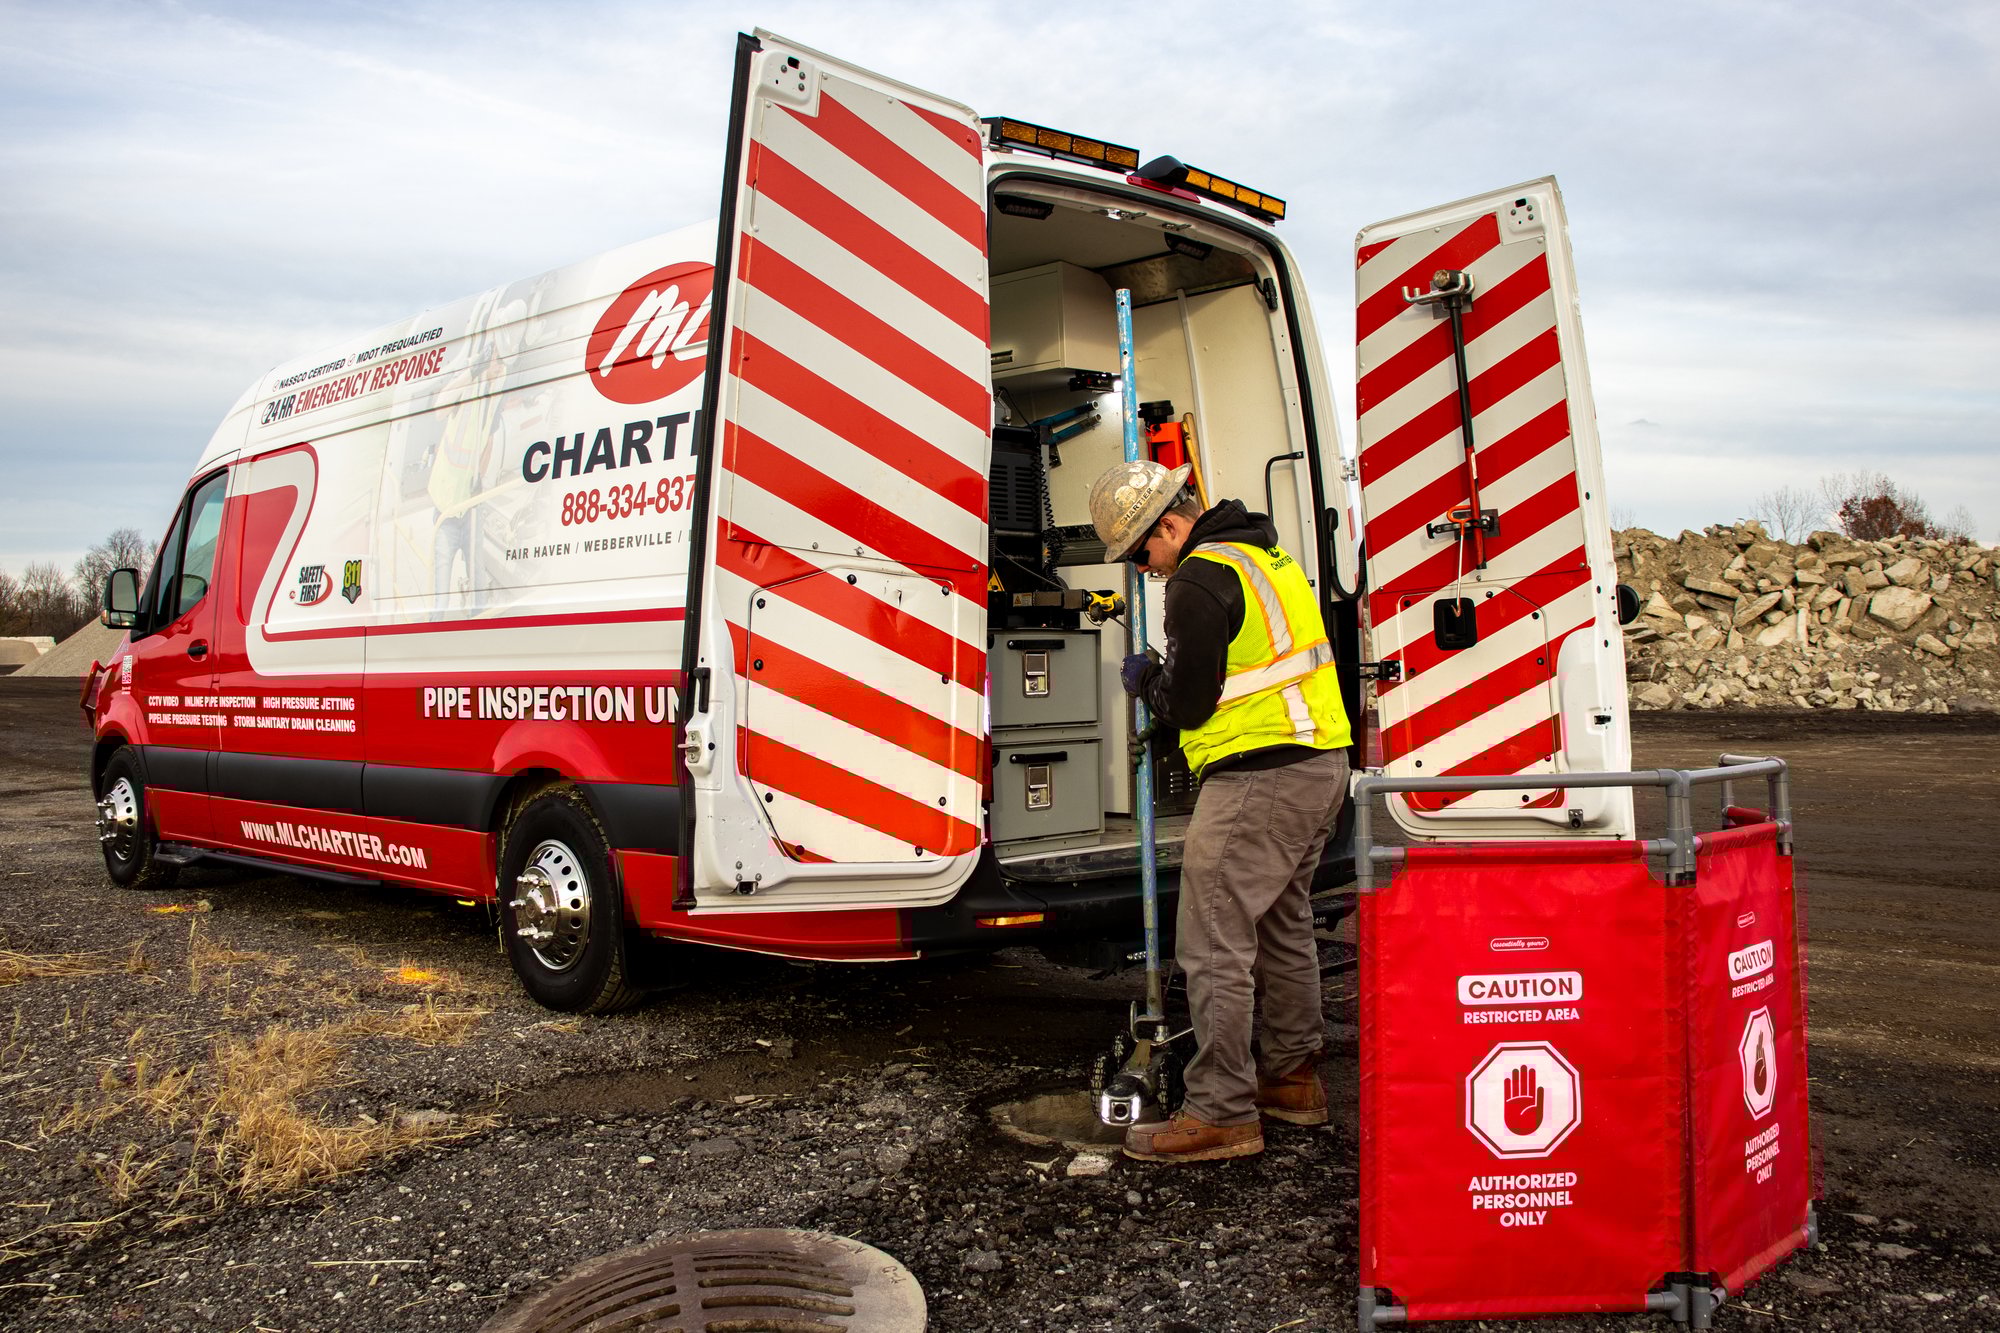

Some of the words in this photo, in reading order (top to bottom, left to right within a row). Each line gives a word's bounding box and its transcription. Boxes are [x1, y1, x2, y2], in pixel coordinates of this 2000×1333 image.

[356, 348, 380, 363] MDOT
[380, 327, 443, 355] PREQUALIFIED
[278, 394, 296, 420] HR
[294, 369, 372, 414] EMERGENCY
[369, 347, 446, 391] RESPONSE
[279, 372, 307, 389] NASSCO
[308, 358, 345, 379] CERTIFIED
[1120, 487, 1153, 526] CHARTIER
[505, 547, 529, 561] FAIR
[534, 543, 571, 558] HAVEN
[584, 531, 672, 553] WEBBERVILLE
[299, 565, 325, 584] SAFETY
[343, 560, 362, 588] 811
[300, 584, 321, 602] FIRST
[148, 696, 162, 707] CCTV
[163, 696, 179, 707] VIDEO
[184, 696, 204, 708] INLINE
[204, 696, 218, 708] PIPE
[219, 696, 256, 709] INSPECTION
[262, 697, 280, 709] HIGH
[281, 697, 319, 710] PRESSURE
[321, 698, 355, 711] JETTING
[424, 687, 471, 718] PIPE
[478, 686, 635, 723] INSPECTION
[148, 713, 172, 725] PIPELINE
[172, 714, 201, 726] PRESSURE
[201, 715, 227, 727] TESTING
[233, 716, 256, 728] STORM
[256, 717, 291, 729] SANITARY
[291, 718, 314, 731] DRAIN
[315, 719, 356, 733] CLEANING
[240, 820, 427, 869] WWW.MLCHARTIER.COM
[1492, 939, 1525, 948] essentially
[1734, 944, 1772, 974] CAUTION
[1468, 977, 1573, 999] CAUTION
[1732, 977, 1765, 999] RESTRICTED
[1464, 1009, 1542, 1024] RESTRICTED
[1545, 1007, 1580, 1021] AREA
[1744, 1122, 1780, 1156] AUTHORIZED
[1746, 1140, 1780, 1174] PERSONNEL
[1468, 1172, 1578, 1192] AUTHORIZED
[1756, 1163, 1773, 1184] ONLY
[1472, 1191, 1573, 1210] PERSONNEL
[1500, 1211, 1547, 1227] ONLY
